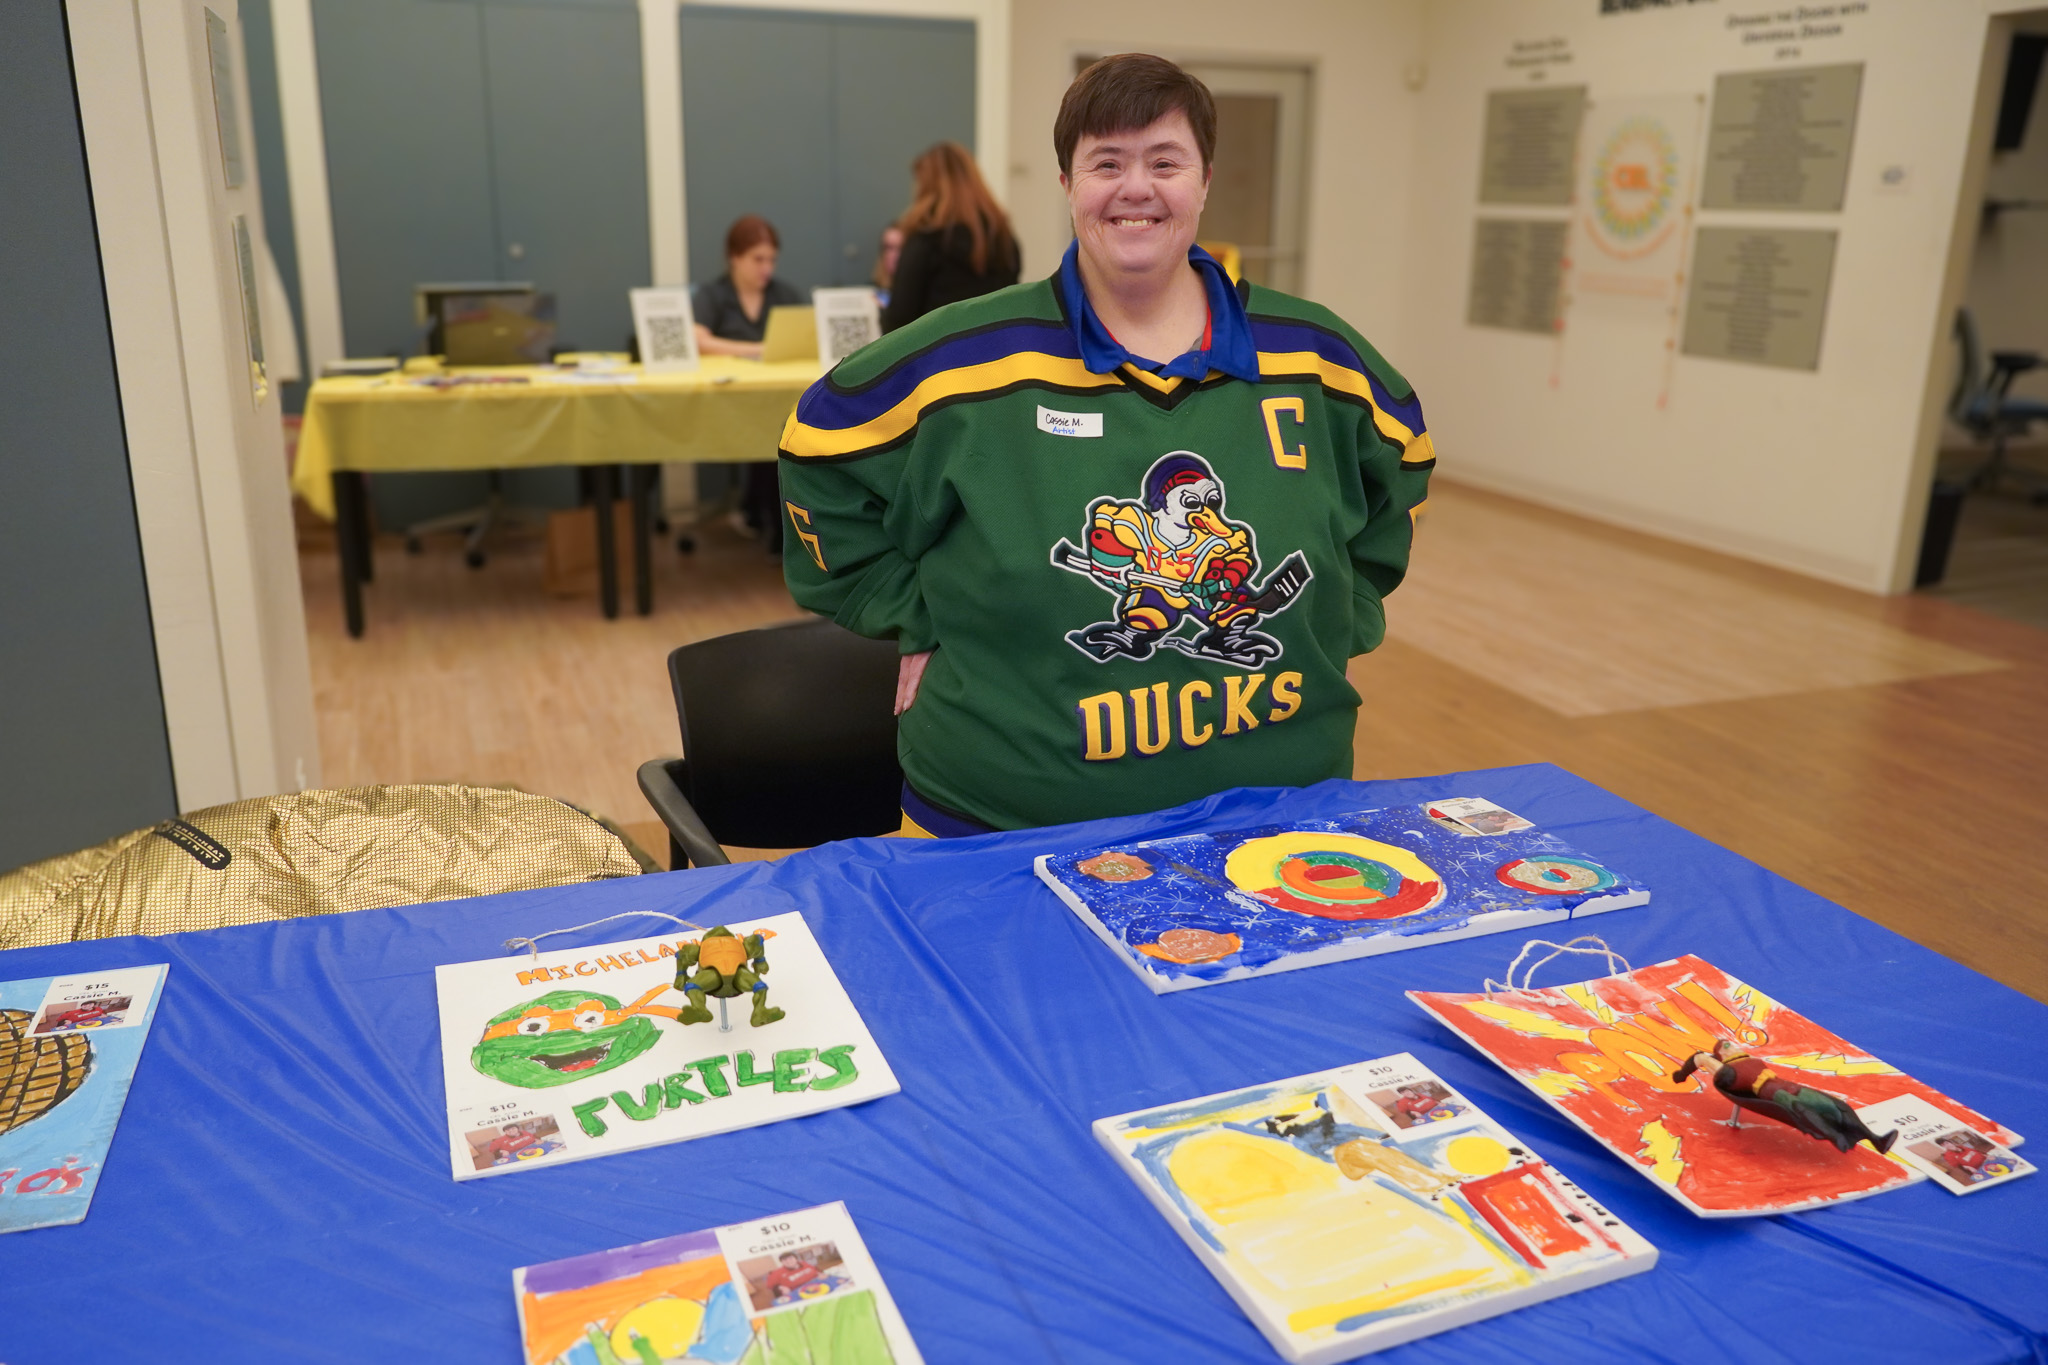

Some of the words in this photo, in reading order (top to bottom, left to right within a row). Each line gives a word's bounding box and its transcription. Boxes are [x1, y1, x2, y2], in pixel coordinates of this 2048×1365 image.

[1045, 413, 1070, 427] Cassie
[1071, 417, 1084, 427] M.
[1052, 425, 1076, 435] Artist
[1260, 394, 1307, 471] C
[1075, 671, 1304, 762] DUCKS
[84, 982, 110, 991] $15
[63, 993, 104, 1001] Cassie
[1368, 1065, 1393, 1076] $10
[1368, 1077, 1404, 1089] Cassie
[571, 1044, 860, 1139] TURTLES
[489, 1102, 517, 1113] $10
[476, 1113, 519, 1127] Cassie
[522, 1109, 538, 1118] M.
[1893, 1114, 1919, 1127] $10
[1902, 1127, 1936, 1141] Cassie
[759, 1222, 791, 1236] $10
[748, 1238, 796, 1254] Cassie
